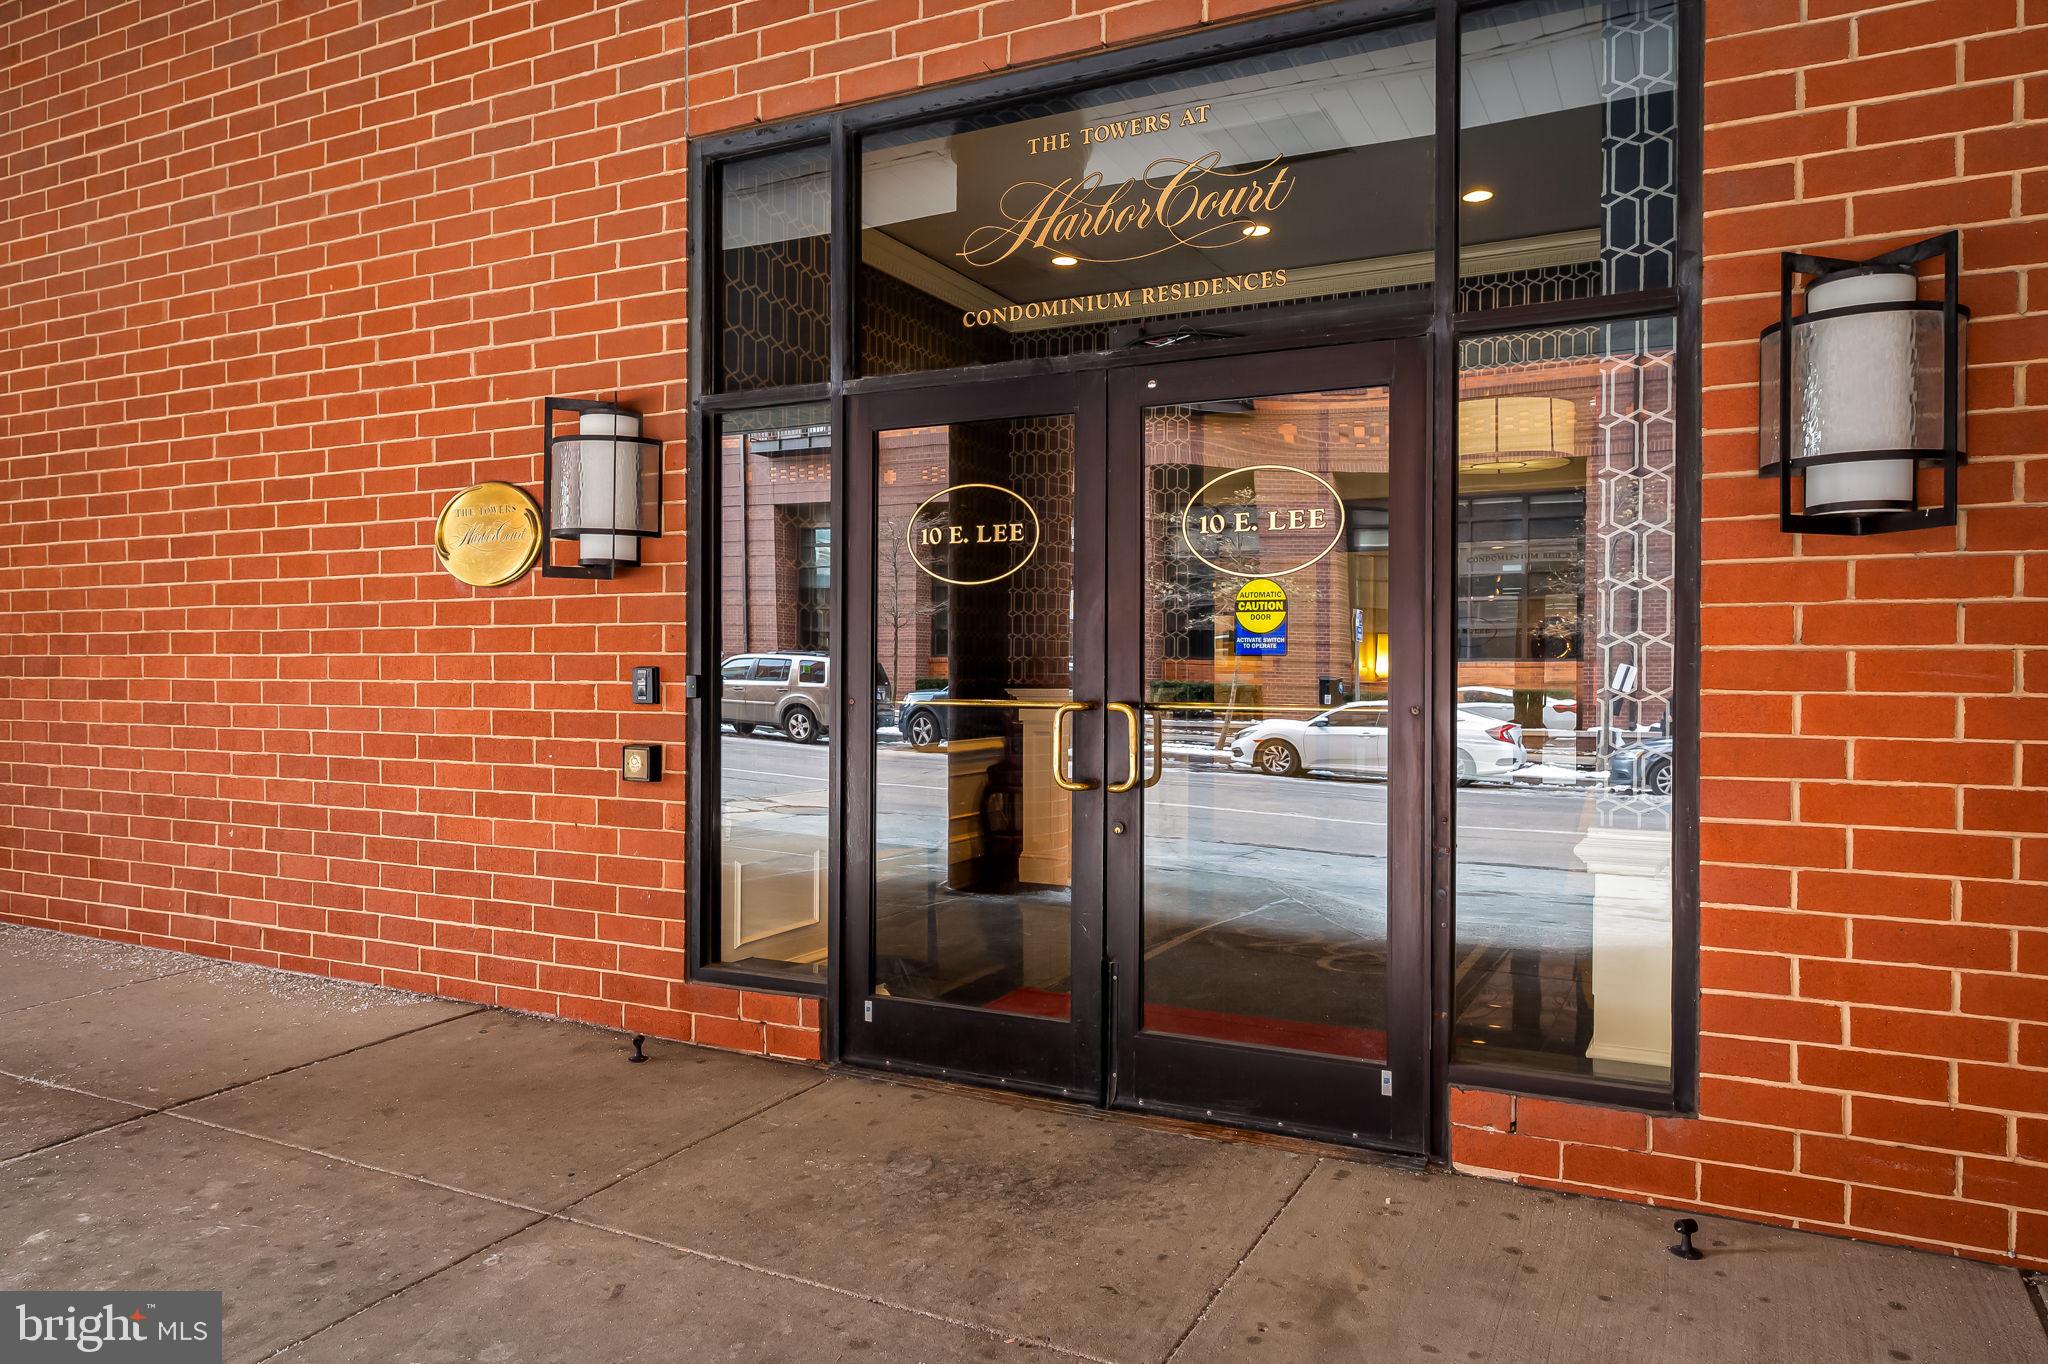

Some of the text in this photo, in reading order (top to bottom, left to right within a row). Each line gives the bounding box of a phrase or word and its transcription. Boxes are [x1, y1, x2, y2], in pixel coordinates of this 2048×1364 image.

[1028, 104, 1212, 156] THE TOWERS AT
[962, 268, 1288, 329] CONDOMINIUM RESIDENCES
[920, 522, 1026, 546] 10 E. LEE
[1199, 508, 1327, 535] 10 E. LEE
[1238, 602, 1284, 610] CAUTION
